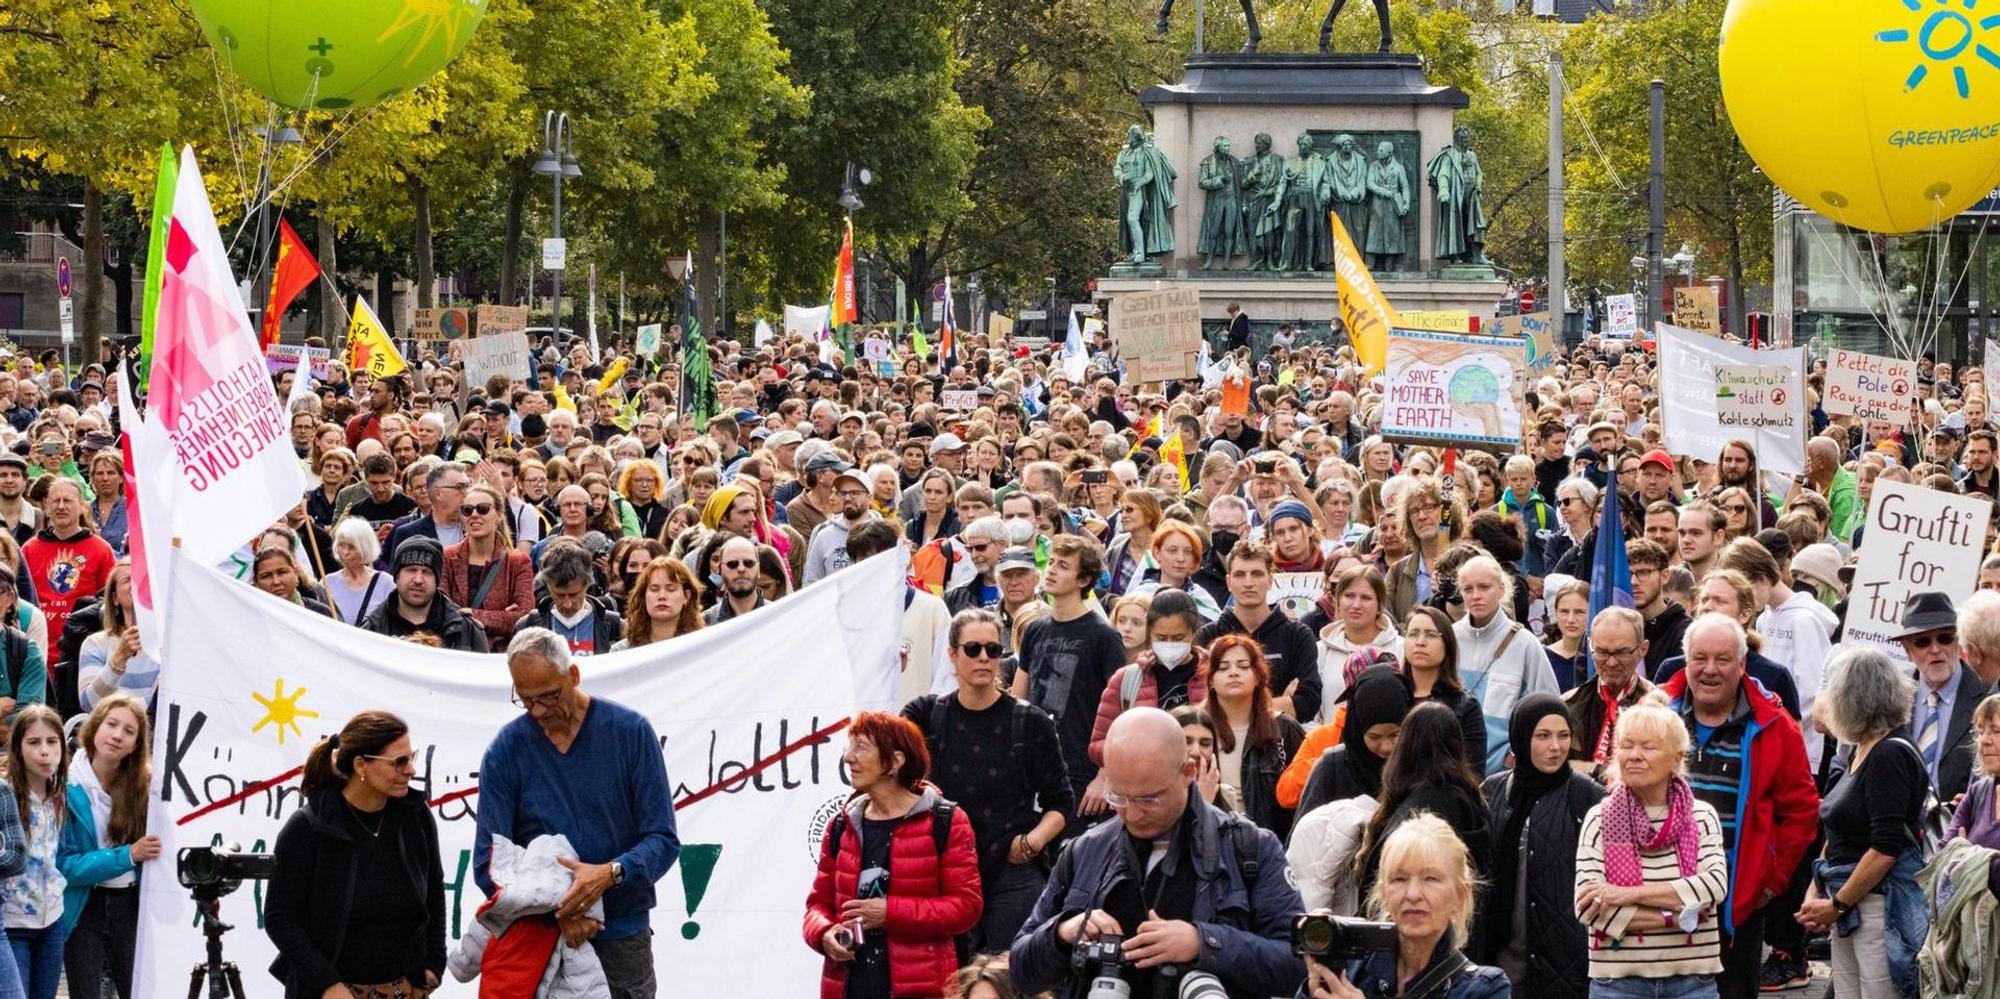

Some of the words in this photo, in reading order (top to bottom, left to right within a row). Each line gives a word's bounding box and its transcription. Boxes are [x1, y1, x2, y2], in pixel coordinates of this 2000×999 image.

[1888, 122, 2000, 149] GREENPEACE
[1122, 295, 1162, 312] GEHT
[1167, 290, 1199, 307] MAL
[416, 310, 430, 318] DIE
[480, 352, 518, 370] WITHOUT
[1836, 351, 1883, 374] Rettet
[1888, 364, 1909, 377] die
[1407, 369, 1440, 385] SAVE
[1715, 367, 1787, 386] Klimaschutz
[1857, 375, 1888, 393] Pole
[1391, 385, 1445, 405] MOTHER
[1738, 388, 1764, 405] statt
[1830, 385, 1862, 404] Raus
[1868, 398, 1888, 411] aus
[1889, 398, 1910, 411] der
[1396, 407, 1453, 429] EARTH
[1853, 404, 1889, 421] Kohle
[1878, 493, 1973, 547] Grufti
[1897, 541, 1945, 586] for
